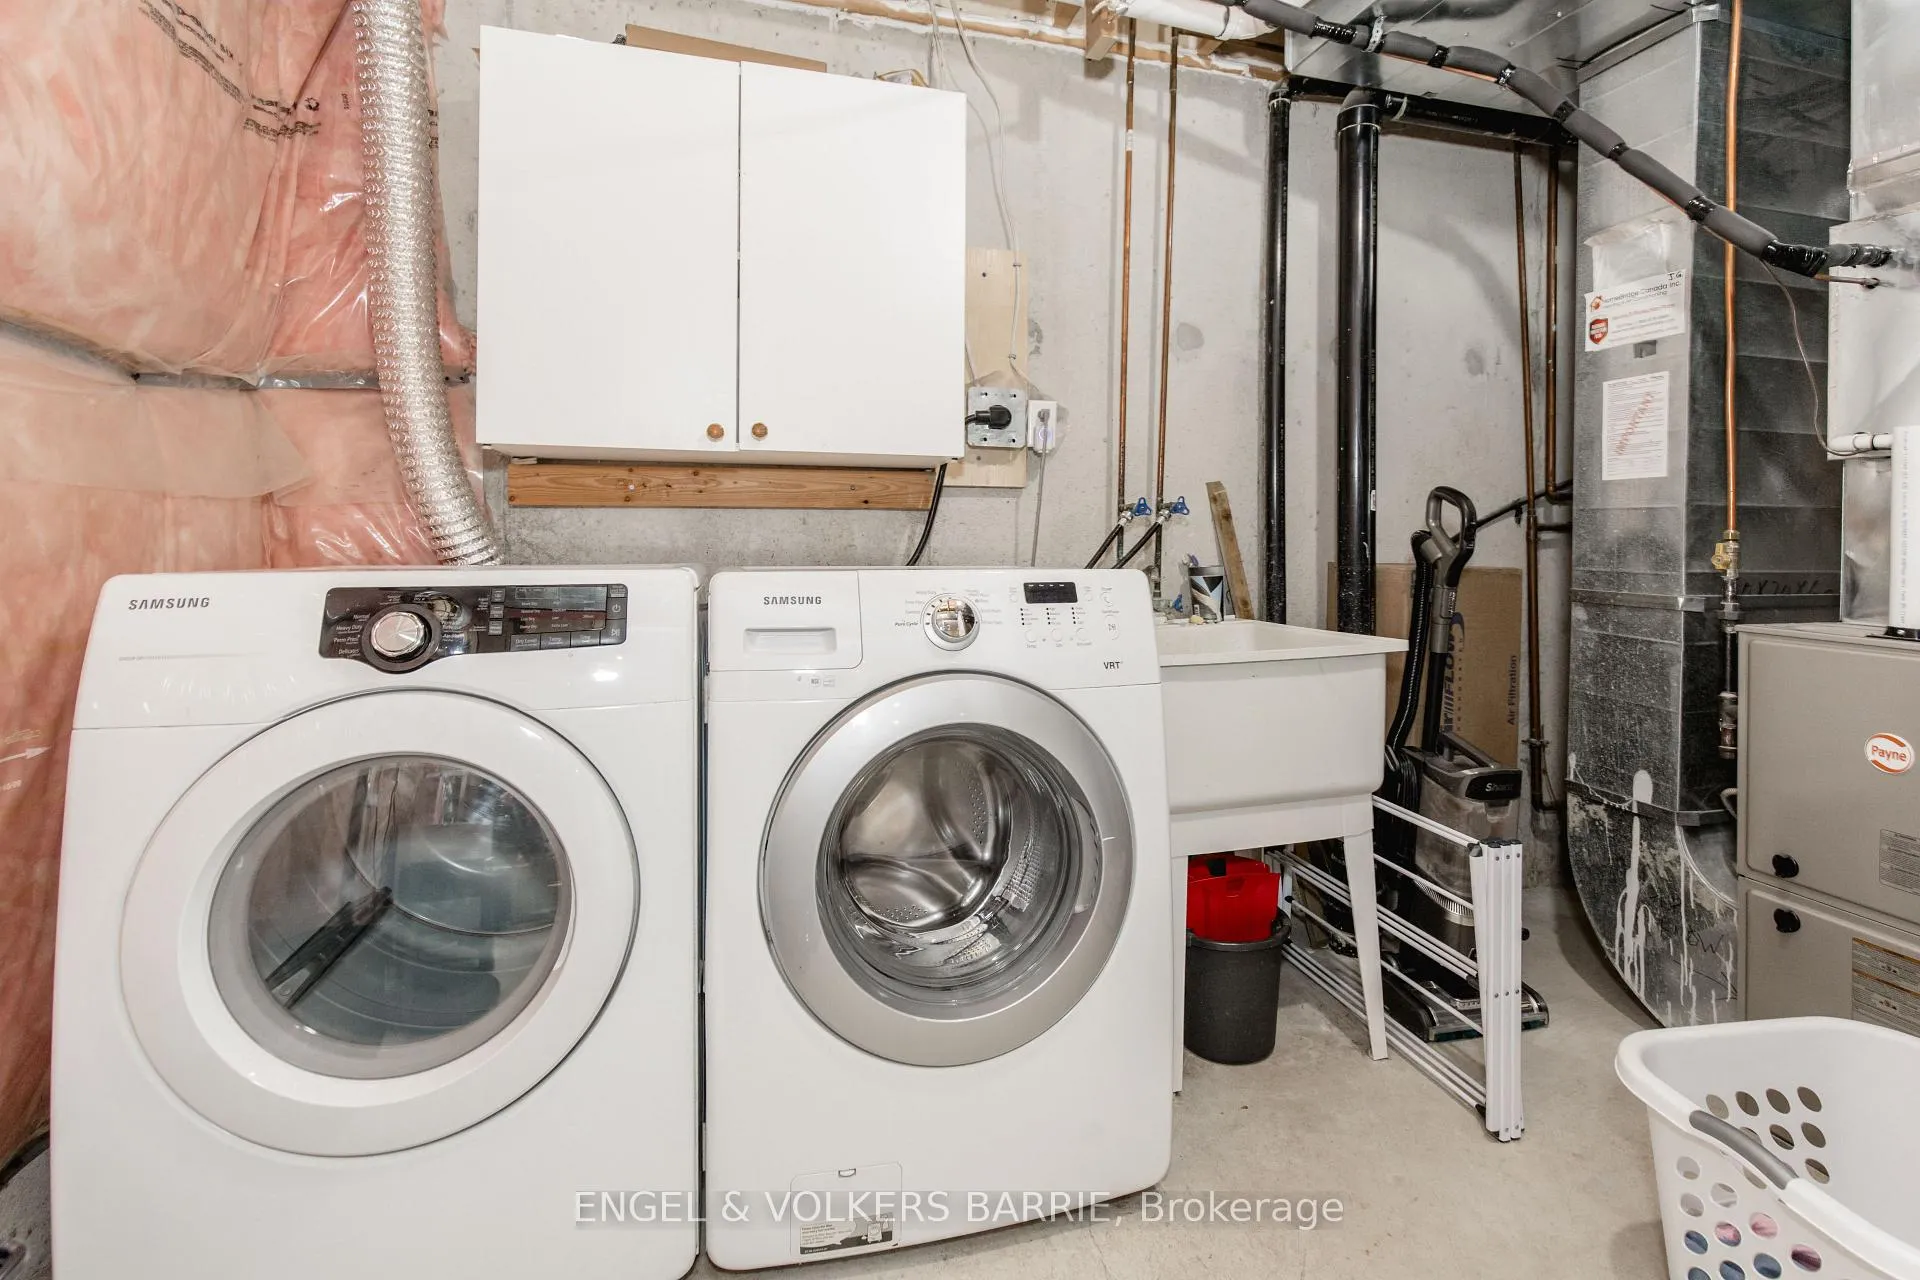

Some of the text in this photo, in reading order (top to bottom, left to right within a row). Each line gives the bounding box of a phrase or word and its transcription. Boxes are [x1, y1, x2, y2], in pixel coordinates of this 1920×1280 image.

[127, 597, 211, 611] SAMSUNG
[762, 596, 823, 605] SAMSUNG
[1103, 661, 1121, 670] VRT
[1507, 655, 1517, 726] Air Filtration
[1871, 744, 1907, 762] Payne
